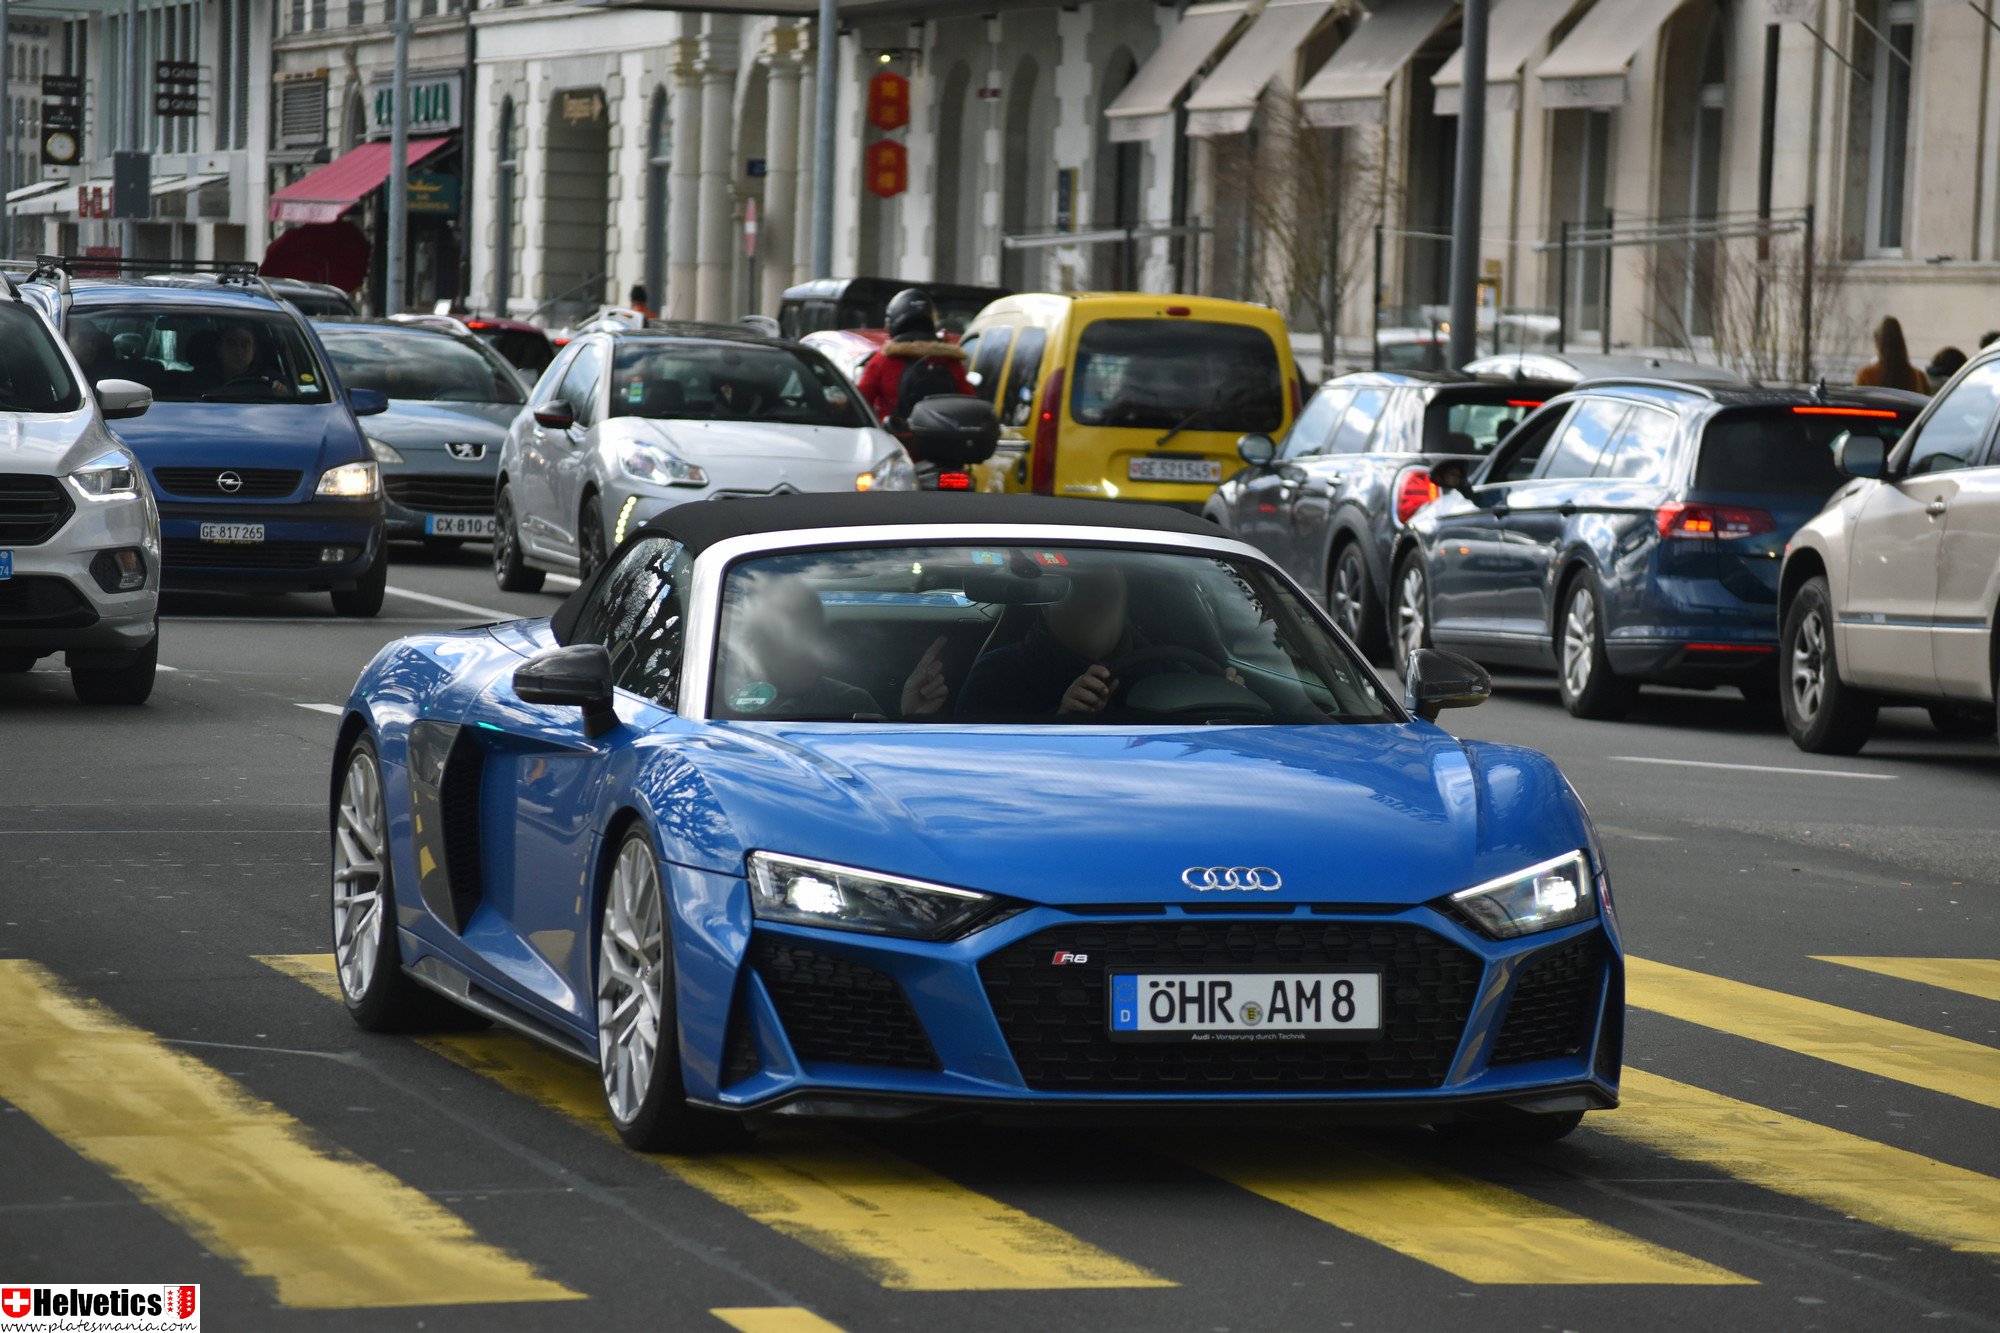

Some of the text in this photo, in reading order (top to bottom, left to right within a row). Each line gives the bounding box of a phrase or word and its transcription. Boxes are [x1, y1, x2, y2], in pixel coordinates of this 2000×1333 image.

[1061, 953, 1088, 964] R8
[1149, 979, 1356, 1024] ÖHR AM 8
[1120, 1009, 1131, 1022] D
[1191, 1033, 1211, 1041] Audi
[1215, 1033, 1255, 1042] Vorsprung
[1255, 1033, 1278, 1041] durch
[1278, 1033, 1306, 1041] Technik
